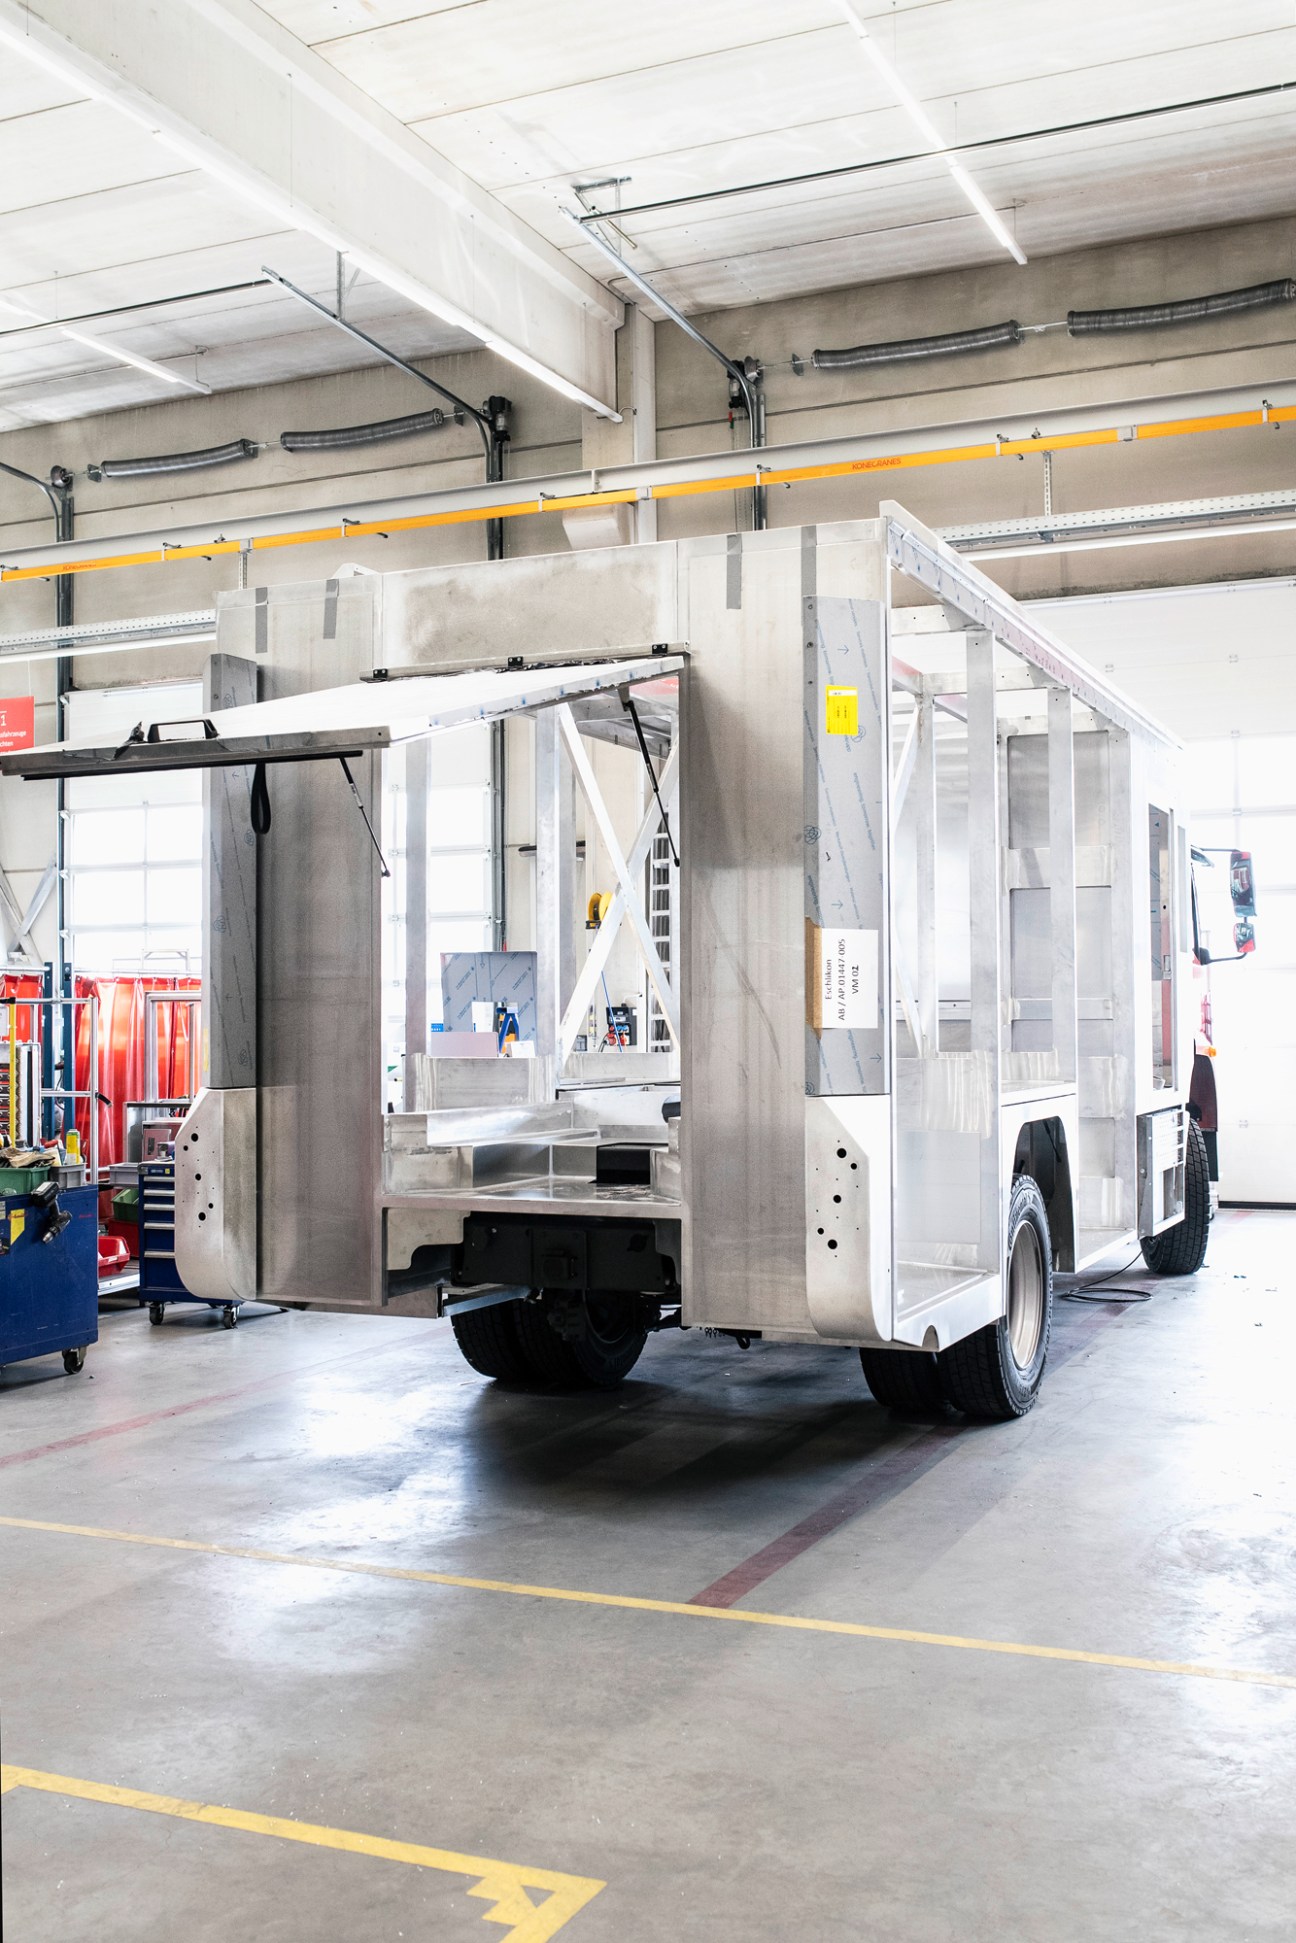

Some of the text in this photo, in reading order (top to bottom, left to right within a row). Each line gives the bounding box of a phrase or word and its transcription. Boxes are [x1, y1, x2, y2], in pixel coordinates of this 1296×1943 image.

[851, 457, 902, 470] KONECRANES
[824, 959, 832, 1000] Eschlikon
[851, 979, 859, 995] VM
[838, 1008, 845, 1020] AB
